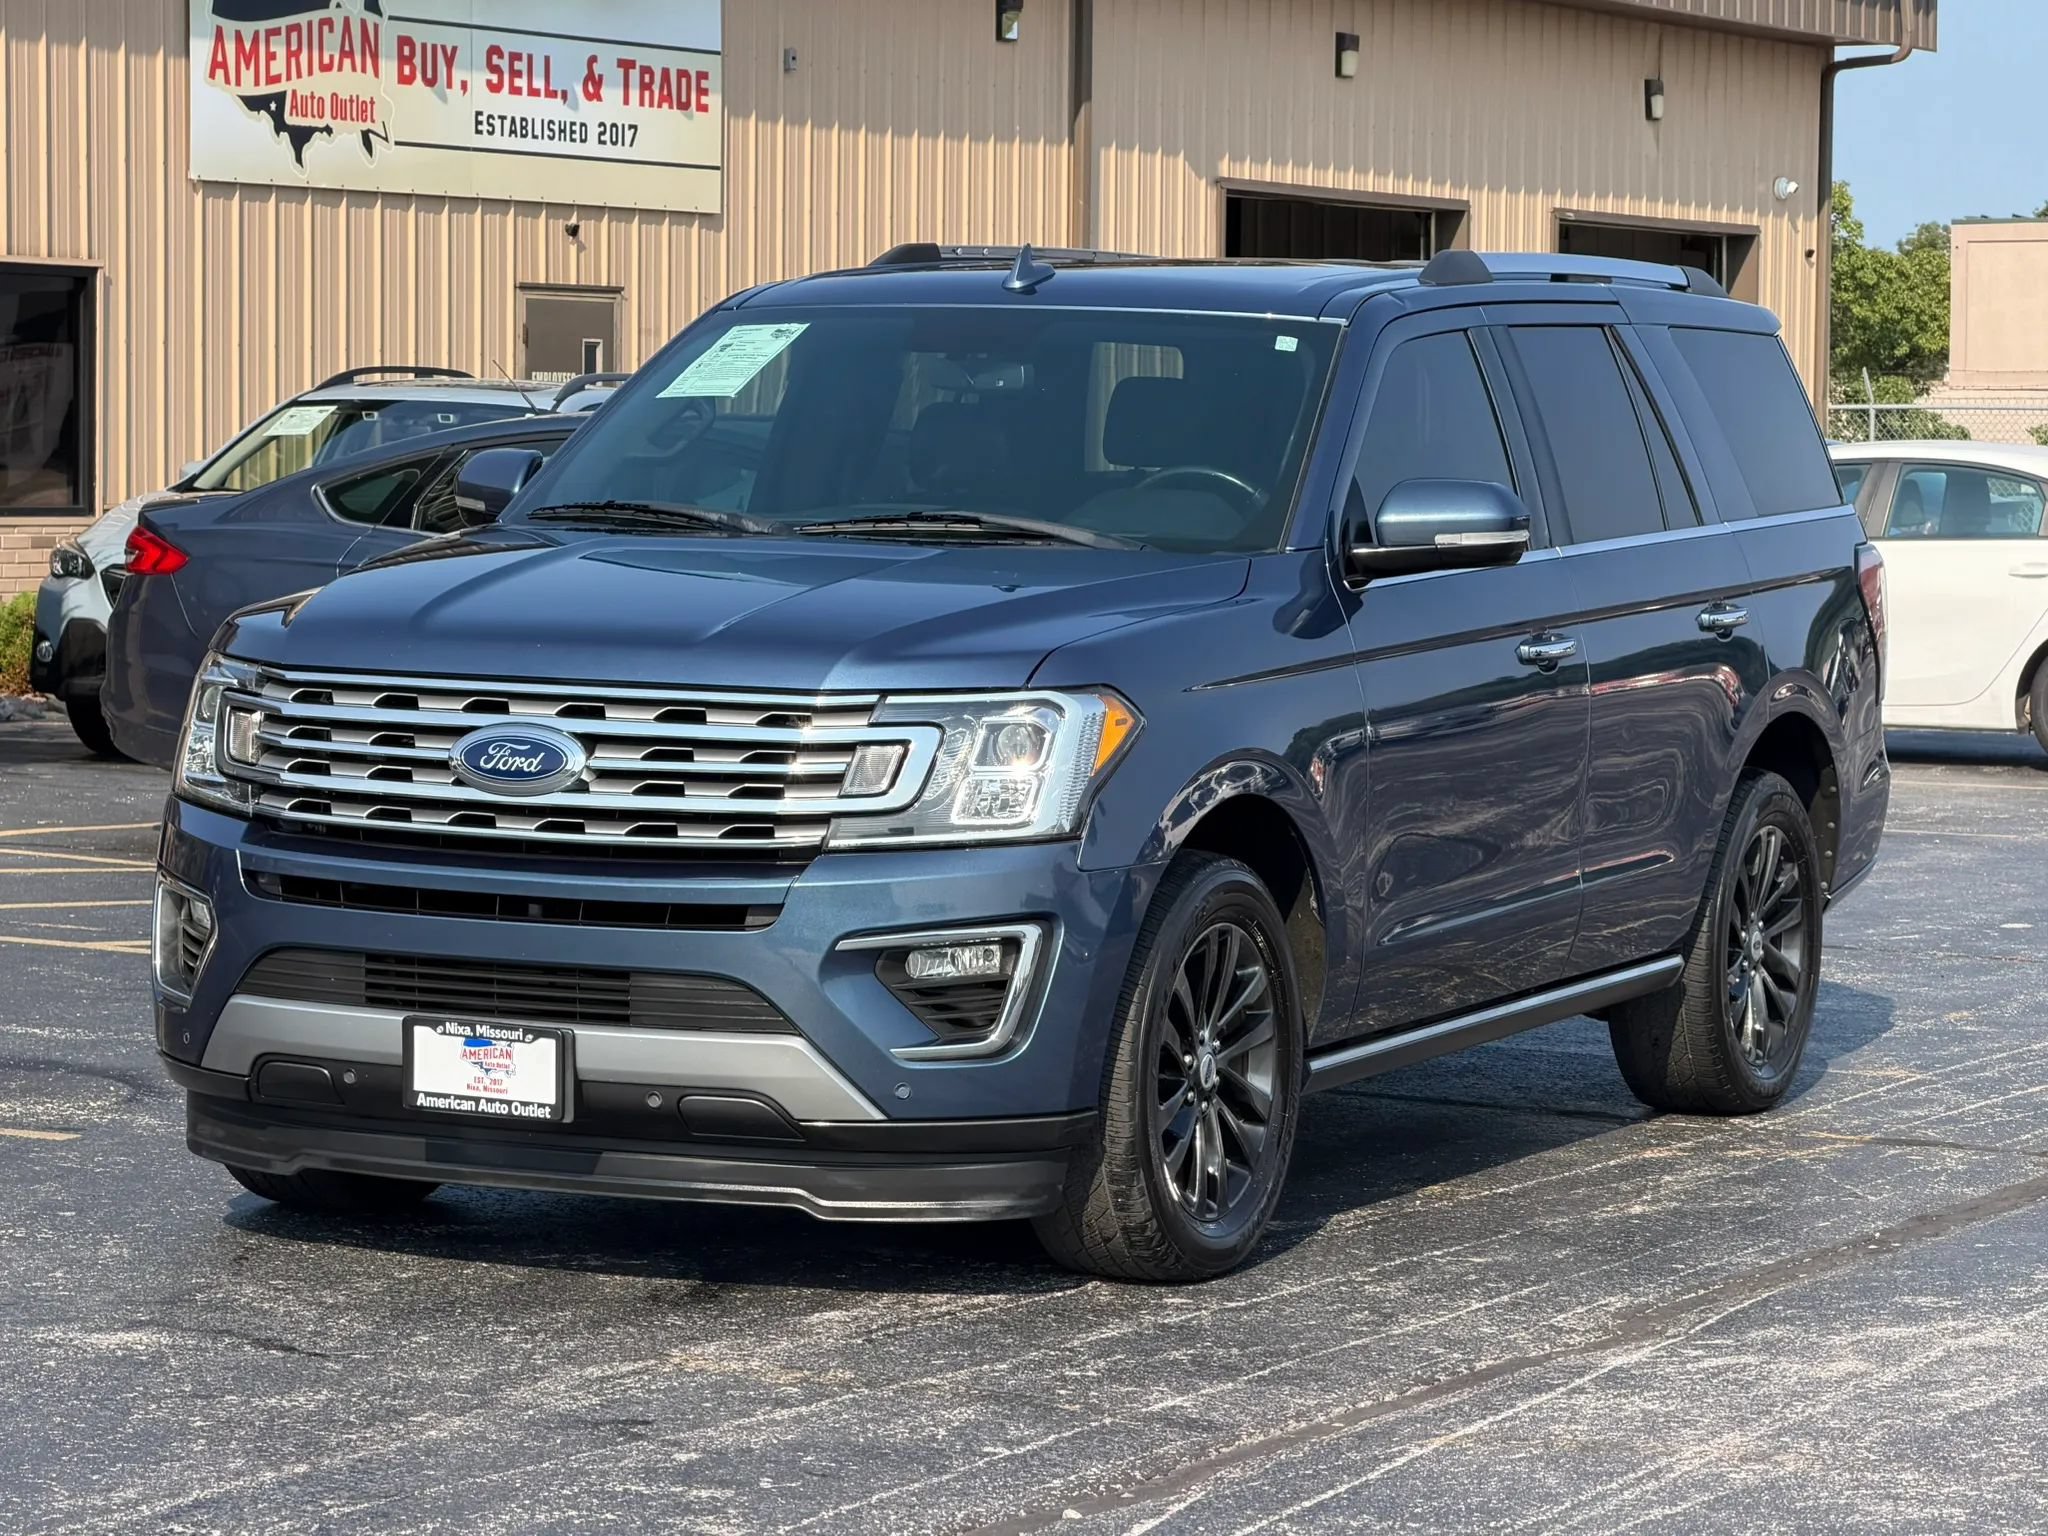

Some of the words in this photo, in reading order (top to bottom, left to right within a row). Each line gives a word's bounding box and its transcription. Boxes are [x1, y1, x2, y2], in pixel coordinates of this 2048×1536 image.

[208, 15, 380, 87] AMERICAN
[396, 34, 468, 97] BUY,
[485, 44, 568, 105] SELL,
[582, 54, 604, 102] &
[616, 57, 709, 113] TRADE
[289, 89, 325, 119] Auto
[330, 92, 376, 124] Outlet
[474, 110, 588, 144] ESTABLISHED
[597, 121, 639, 148] 2017
[479, 741, 546, 773] Ford
[445, 1021, 473, 1037] Nixa,
[475, 1024, 524, 1041] Missouri
[462, 1047, 512, 1060] AMERICAN
[482, 1085, 508, 1094] Missouri
[489, 1078, 503, 1086] 2017
[416, 1093, 476, 1112] American
[478, 1098, 509, 1115] Auto
[511, 1102, 551, 1119] Outlet
